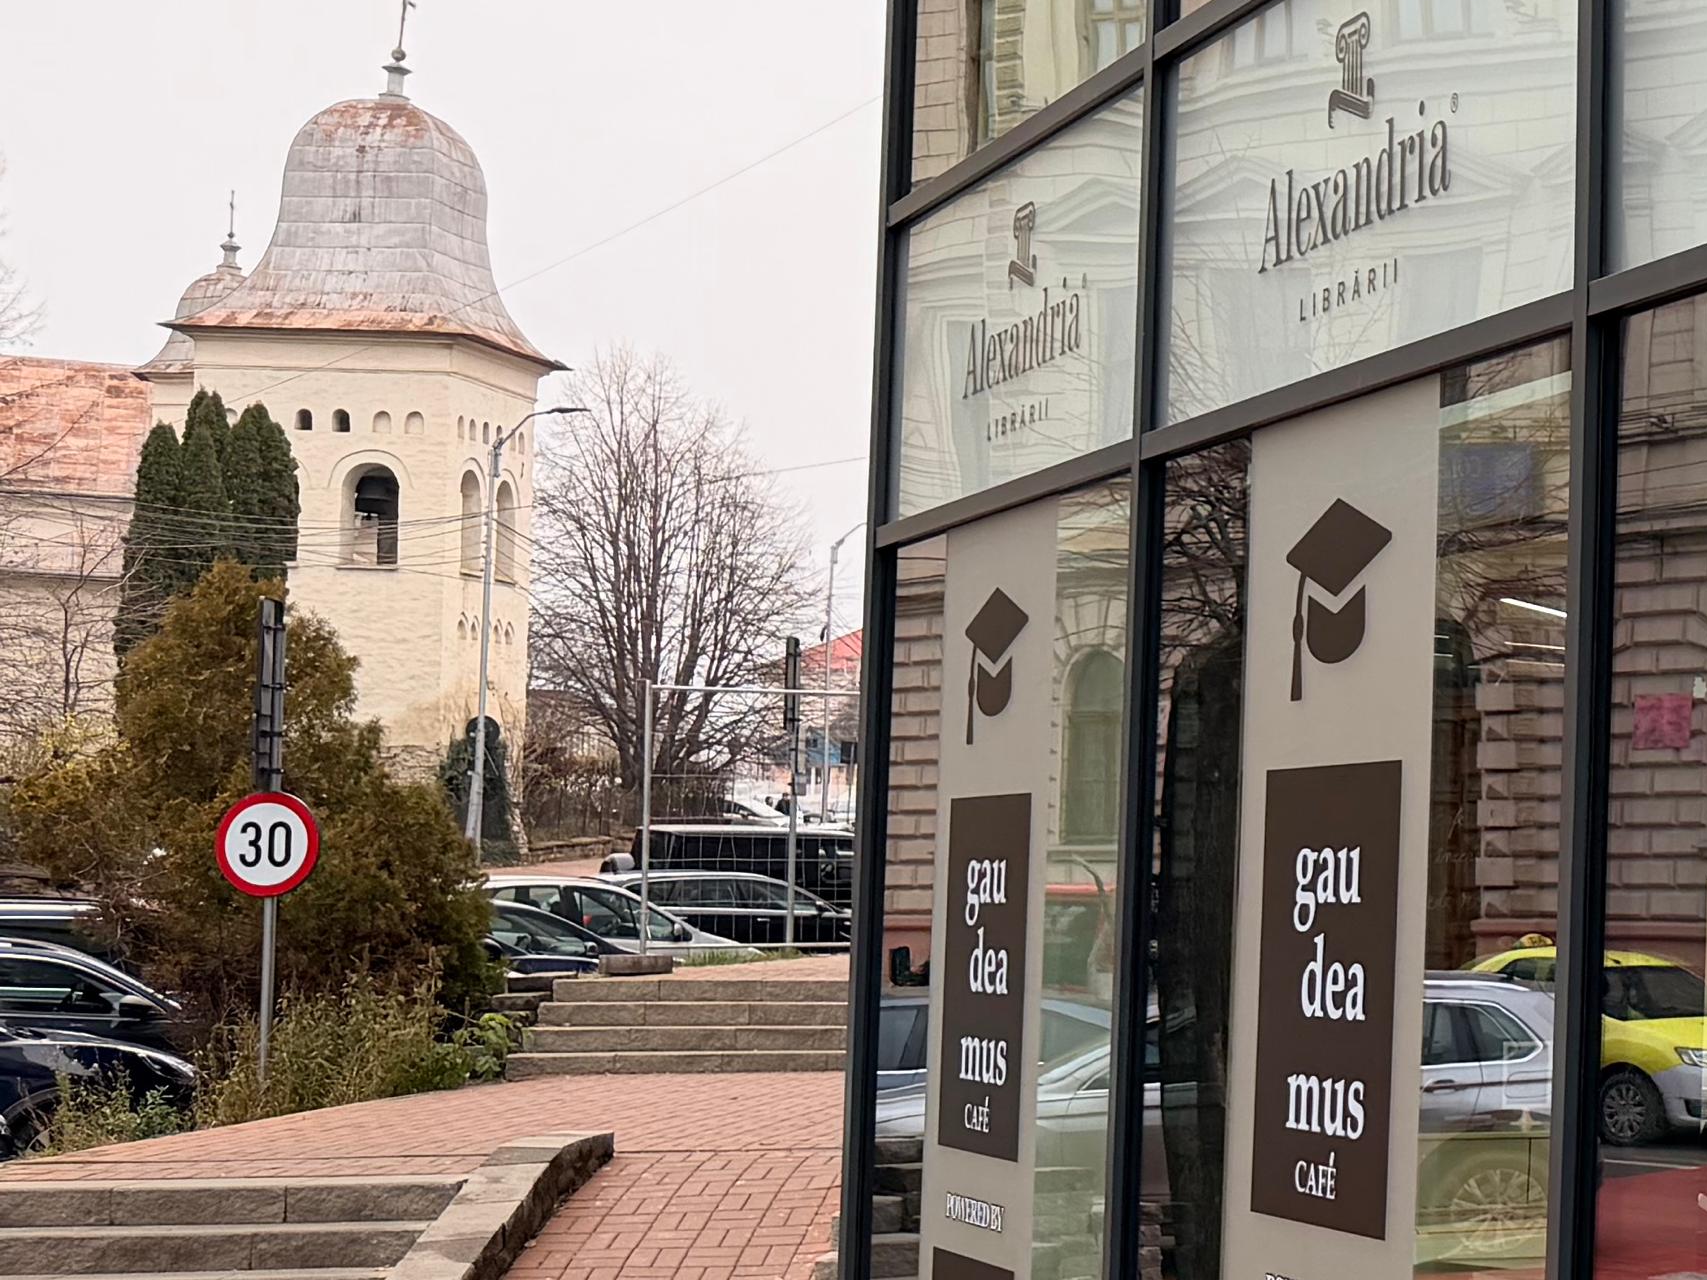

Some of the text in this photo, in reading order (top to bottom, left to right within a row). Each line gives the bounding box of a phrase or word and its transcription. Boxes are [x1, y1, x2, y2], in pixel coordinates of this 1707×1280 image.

[1258, 100, 1451, 274] Alexandria
[1299, 258, 1399, 322] LIBRĂRII
[962, 276, 1081, 400] Alexandria
[239, 820, 292, 869] 30
[965, 858, 1007, 926] gau
[1293, 845, 1361, 932] gau
[969, 926, 1008, 995] dea
[1301, 933, 1365, 1021] dea
[959, 1035, 1007, 1086] mus
[964, 1096, 990, 1133] CAFÉ
[1285, 1073, 1364, 1140] mus
[1294, 1151, 1338, 1200] CAFÉ
[946, 1192, 1004, 1233] POWERED BY
